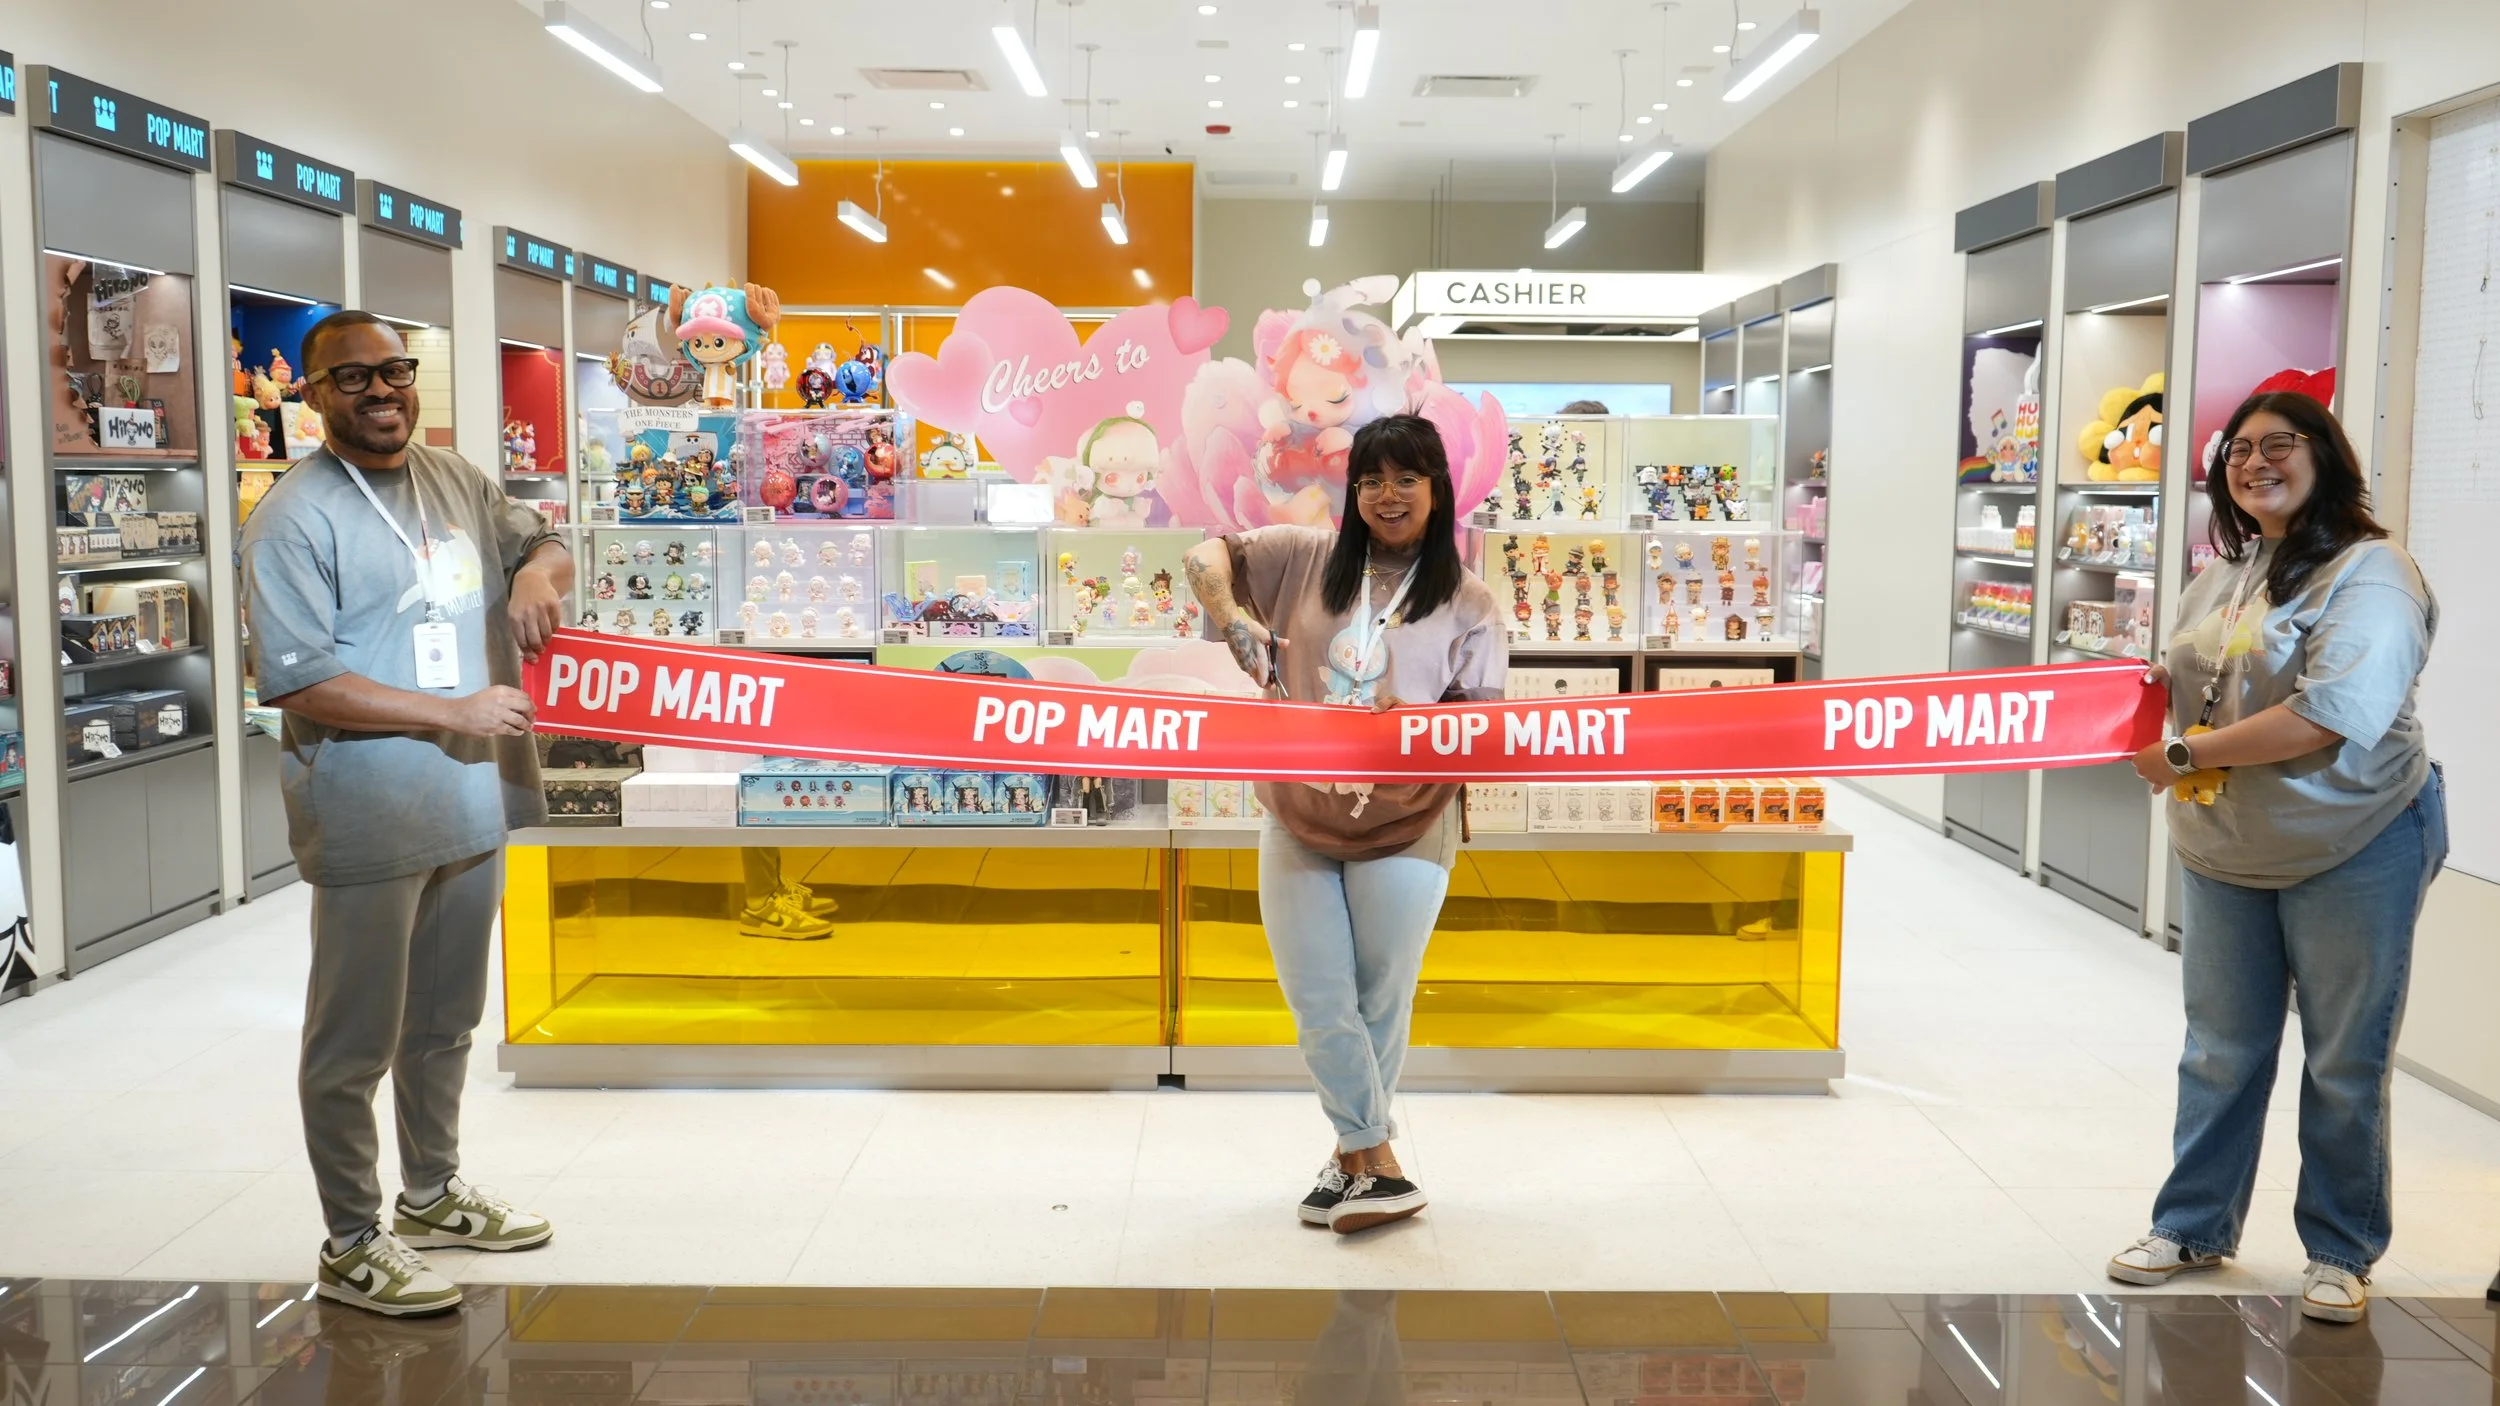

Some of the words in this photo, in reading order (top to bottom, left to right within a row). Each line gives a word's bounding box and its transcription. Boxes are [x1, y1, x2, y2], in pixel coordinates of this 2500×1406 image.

[147, 113, 171, 148] POP
[173, 121, 204, 159] MART
[296, 163, 315, 193] POP
[316, 169, 341, 201] MART
[409, 203, 425, 229] POP
[425, 208, 445, 236] MART
[527, 242, 538, 264] POP
[539, 246, 554, 269] MART
[594, 264, 604, 283] POP
[1446, 281, 1586, 305] CASHIER
[981, 354, 1103, 414] Cheers
[1115, 338, 1150, 374] to
[624, 409, 643, 420] THE
[645, 408, 694, 419] MONSTERS
[634, 420, 654, 428] ONE
[655, 421, 682, 430] PIECE
[547, 655, 639, 713] POP
[650, 666, 786, 727] MART
[972, 696, 1066, 746] POP
[1077, 704, 1209, 752] MART
[1401, 713, 1490, 756] POP
[1503, 707, 1632, 756] MART
[1823, 697, 1914, 750] POP
[1926, 691, 2055, 747] MART
